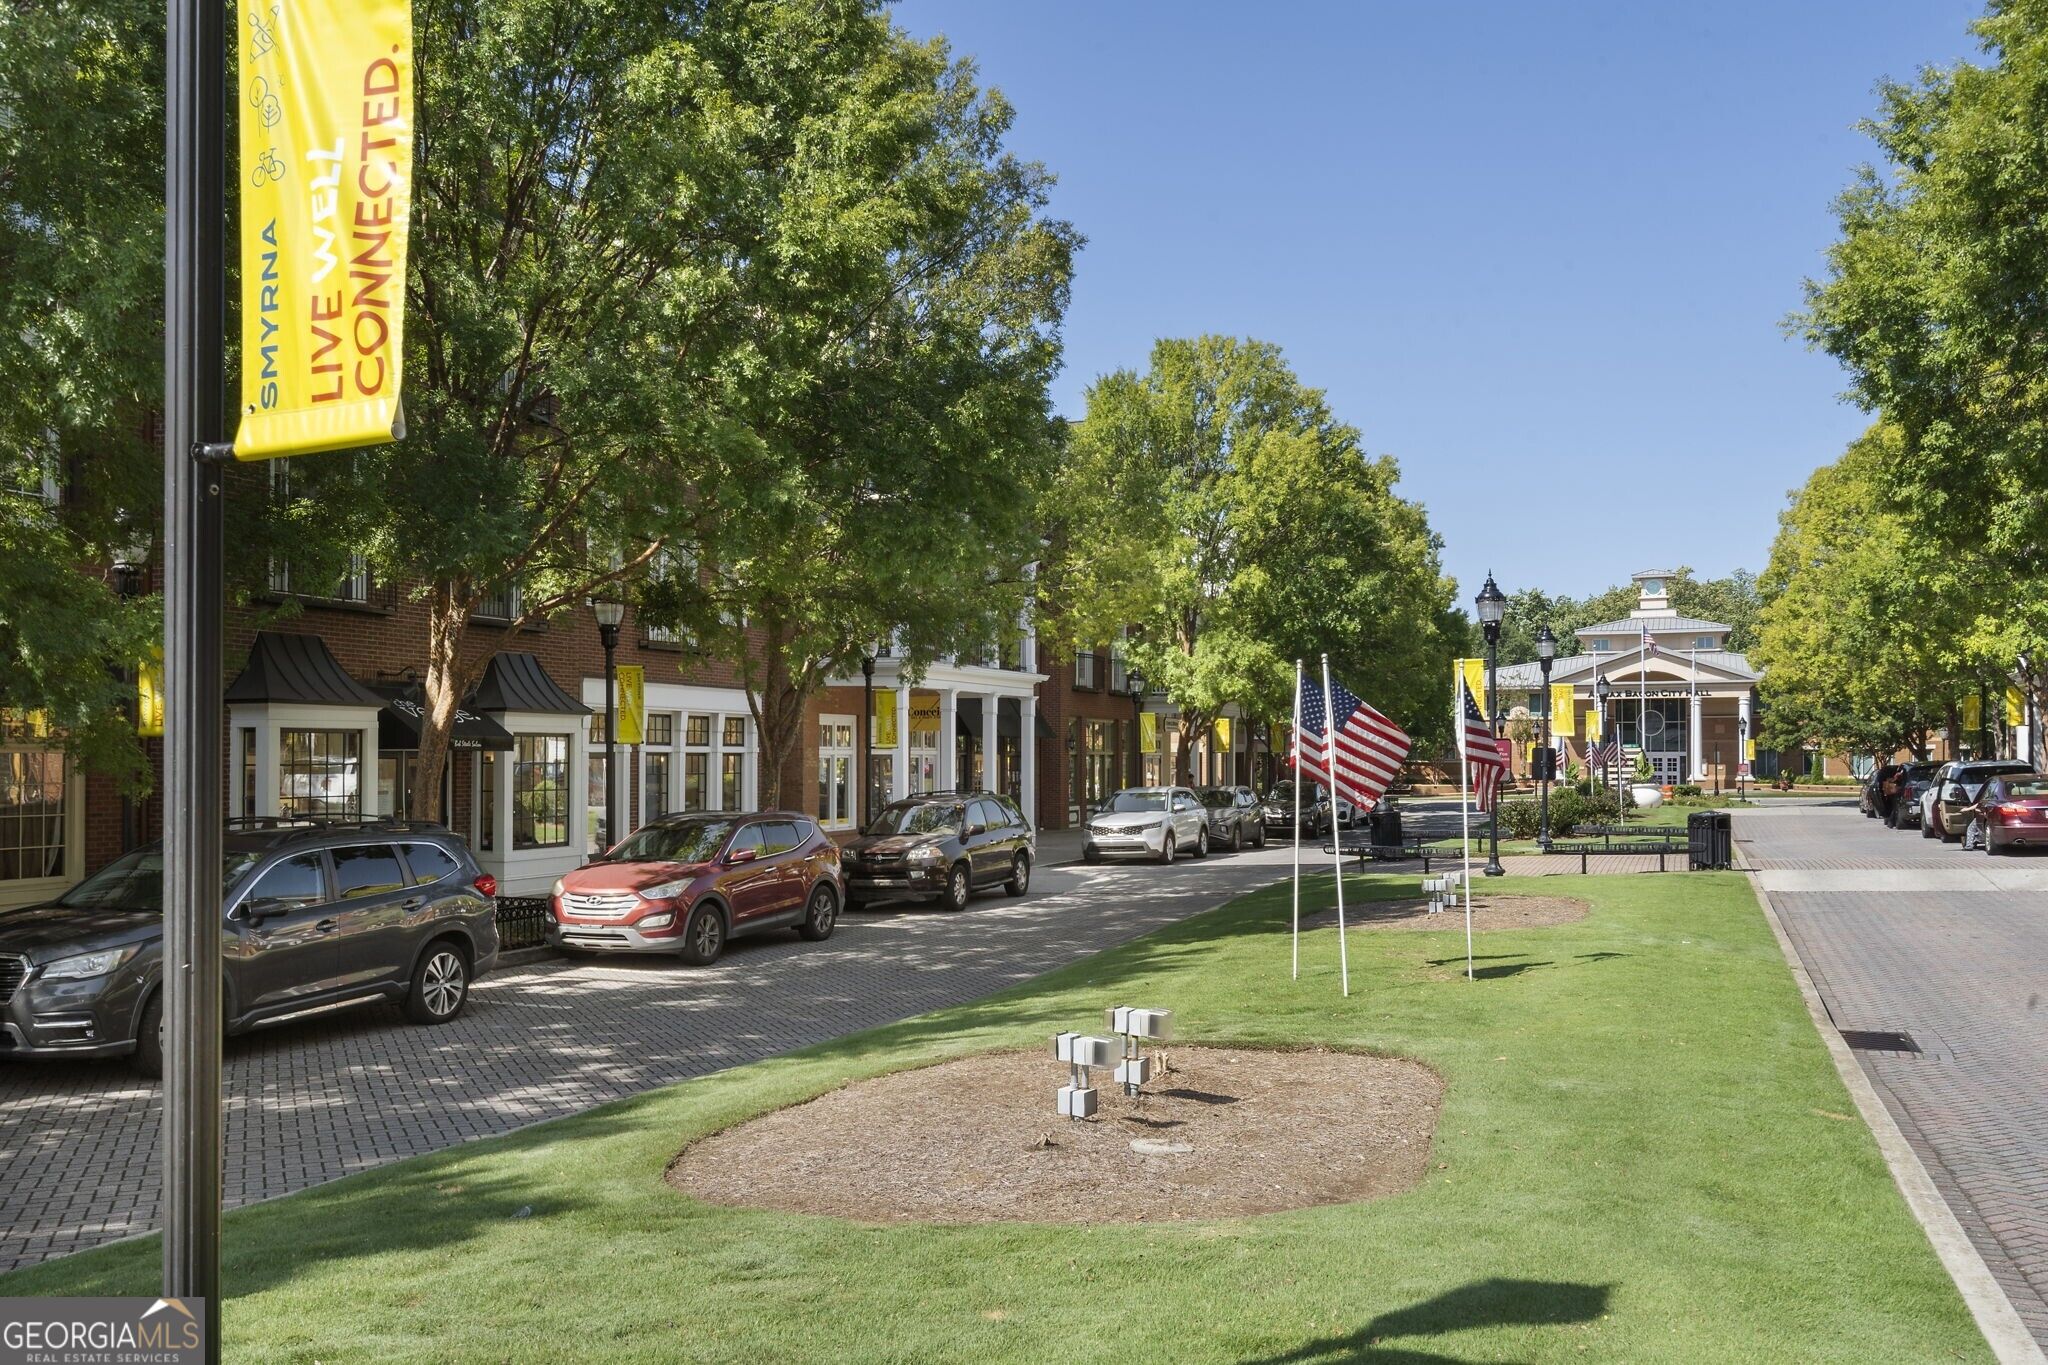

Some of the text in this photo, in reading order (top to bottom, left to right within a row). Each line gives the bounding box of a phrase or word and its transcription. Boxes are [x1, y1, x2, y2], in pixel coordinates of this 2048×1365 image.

[306, 137, 345, 402] LIVE WELL
[349, 43, 400, 396] CONNECTED.
[260, 217, 278, 410] SMYRNA
[154, 704, 163, 727] LIVE
[908, 706, 942, 717] Concei
[1660, 689, 1683, 697] CITY
